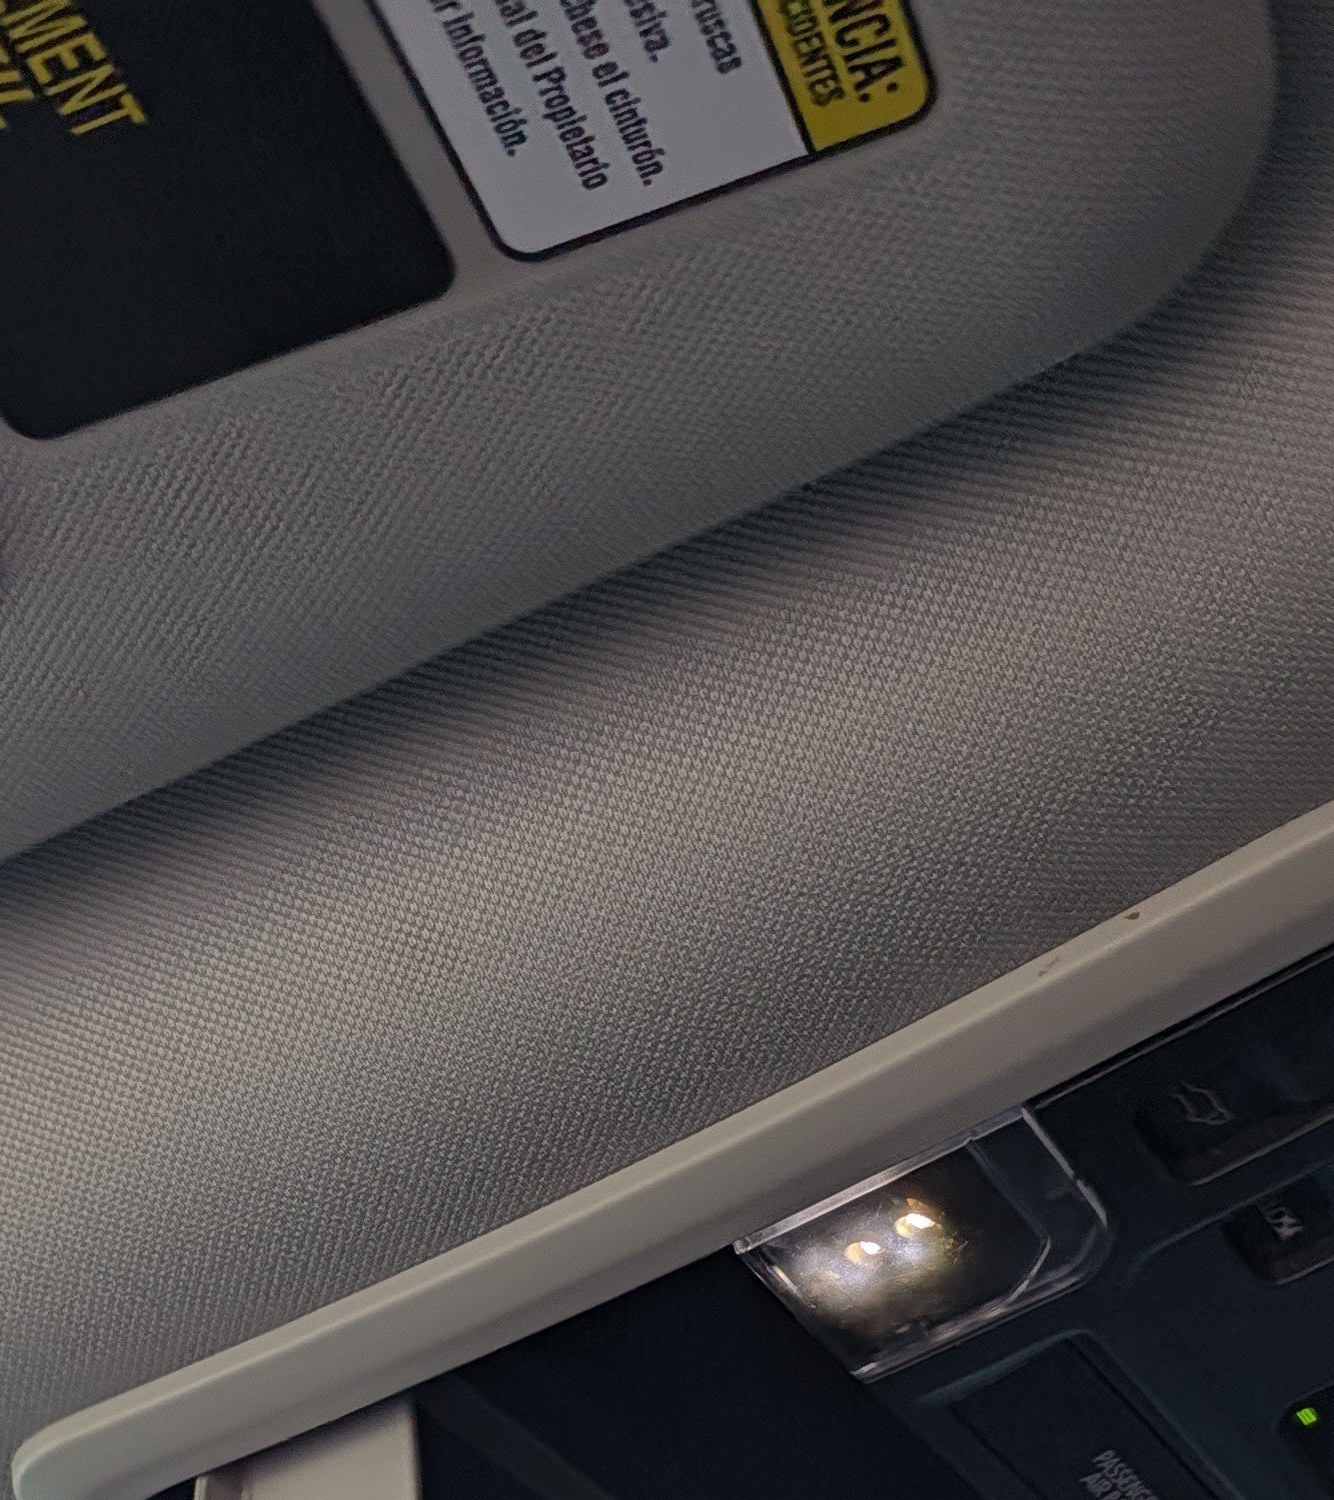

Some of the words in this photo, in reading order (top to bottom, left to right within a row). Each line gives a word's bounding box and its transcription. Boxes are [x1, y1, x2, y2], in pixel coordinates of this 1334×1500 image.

[495, 0, 538, 27] al
[513, 28, 558, 69] del
[592, 61, 631, 87] el
[532, 66, 610, 190] Propietario
[604, 88, 666, 186] cinturón.
[1079, 1472, 1113, 1498] AIR
